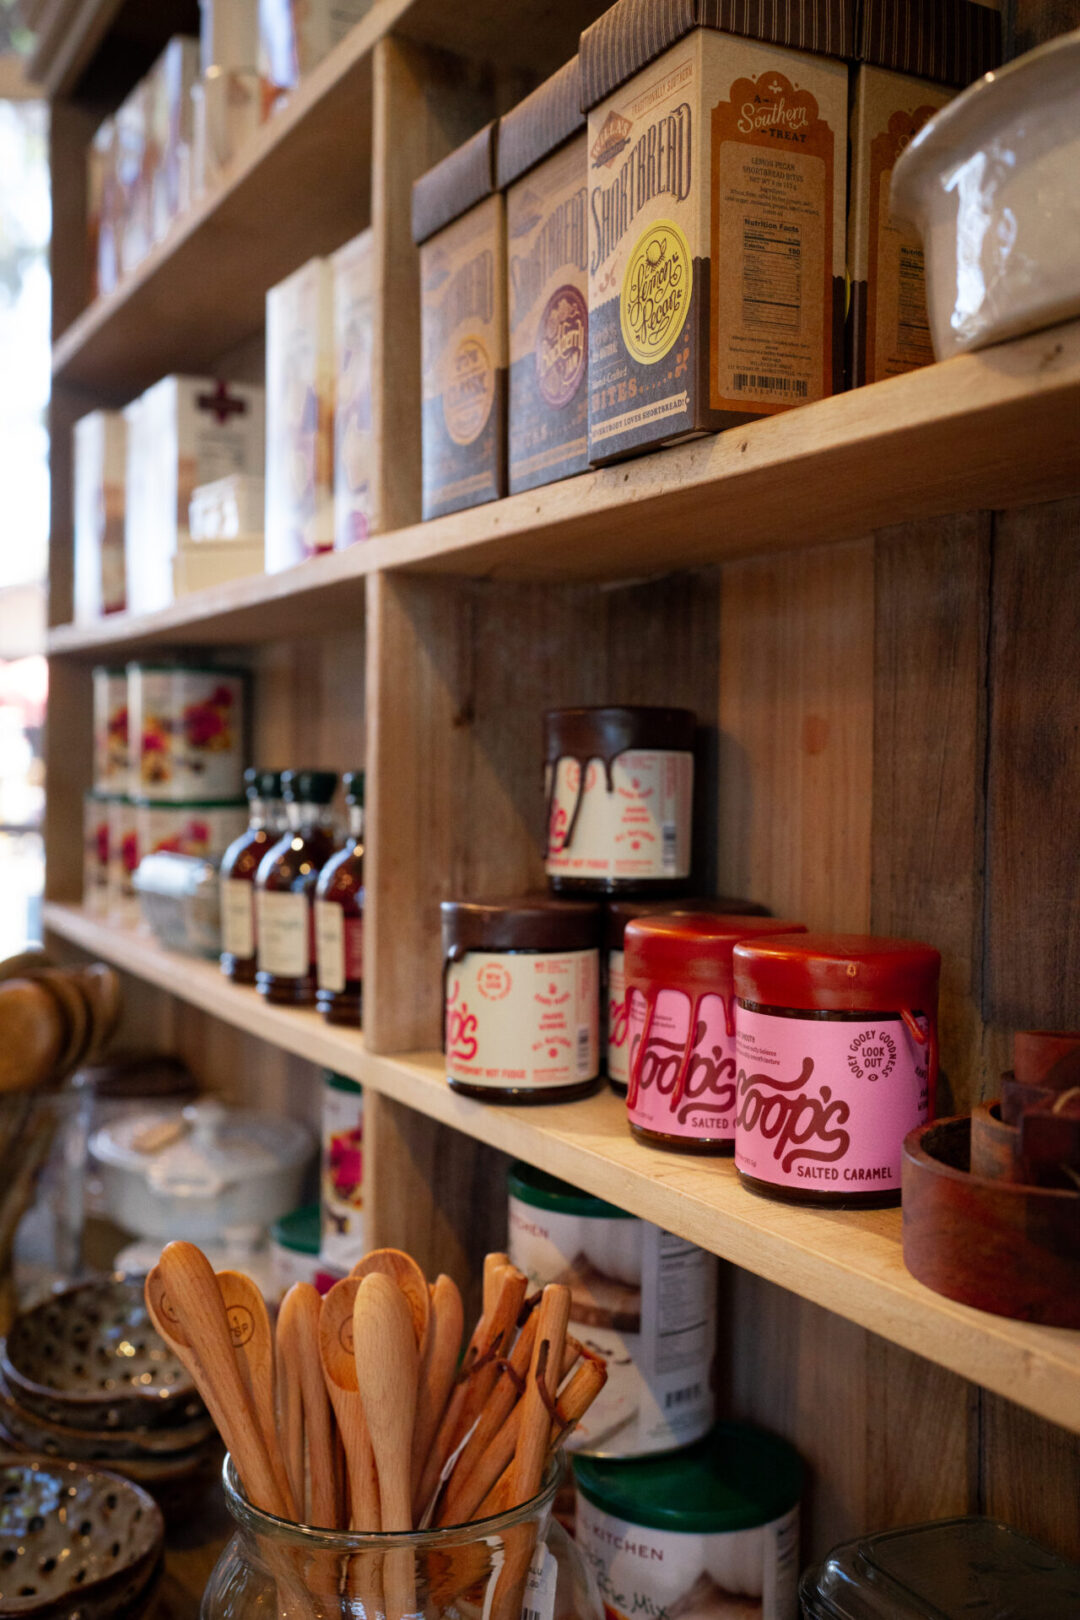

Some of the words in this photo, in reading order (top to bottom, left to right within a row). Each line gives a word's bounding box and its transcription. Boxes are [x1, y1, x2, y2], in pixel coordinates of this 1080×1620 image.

[754, 95, 761, 104] A
[737, 98, 809, 135] Southern
[768, 128, 808, 144] TREAT
[751, 157, 774, 167] LEMON
[775, 161, 795, 171] PECAN
[743, 166, 785, 179] SHORTBREAD
[590, 103, 692, 276] SHORTBREAD
[744, 219, 777, 229] Nutrition
[779, 224, 799, 232] Facts
[630, 253, 682, 303] Lemon
[629, 293, 681, 346] Pecan
[624, 413, 642, 427] LOVES
[850, 1030, 876, 1052] GOOEY
[862, 1047, 885, 1057] LOOK
[879, 1032, 897, 1078] GOODNESS
[848, 1055, 864, 1078] OOEY
[864, 1058, 882, 1068] OUT
[692, 1117, 729, 1129] SALTED
[797, 1166, 838, 1180] SALTED
[843, 1166, 893, 1180] CARAMEL
[593, 1526, 663, 1560] KITCHEN
